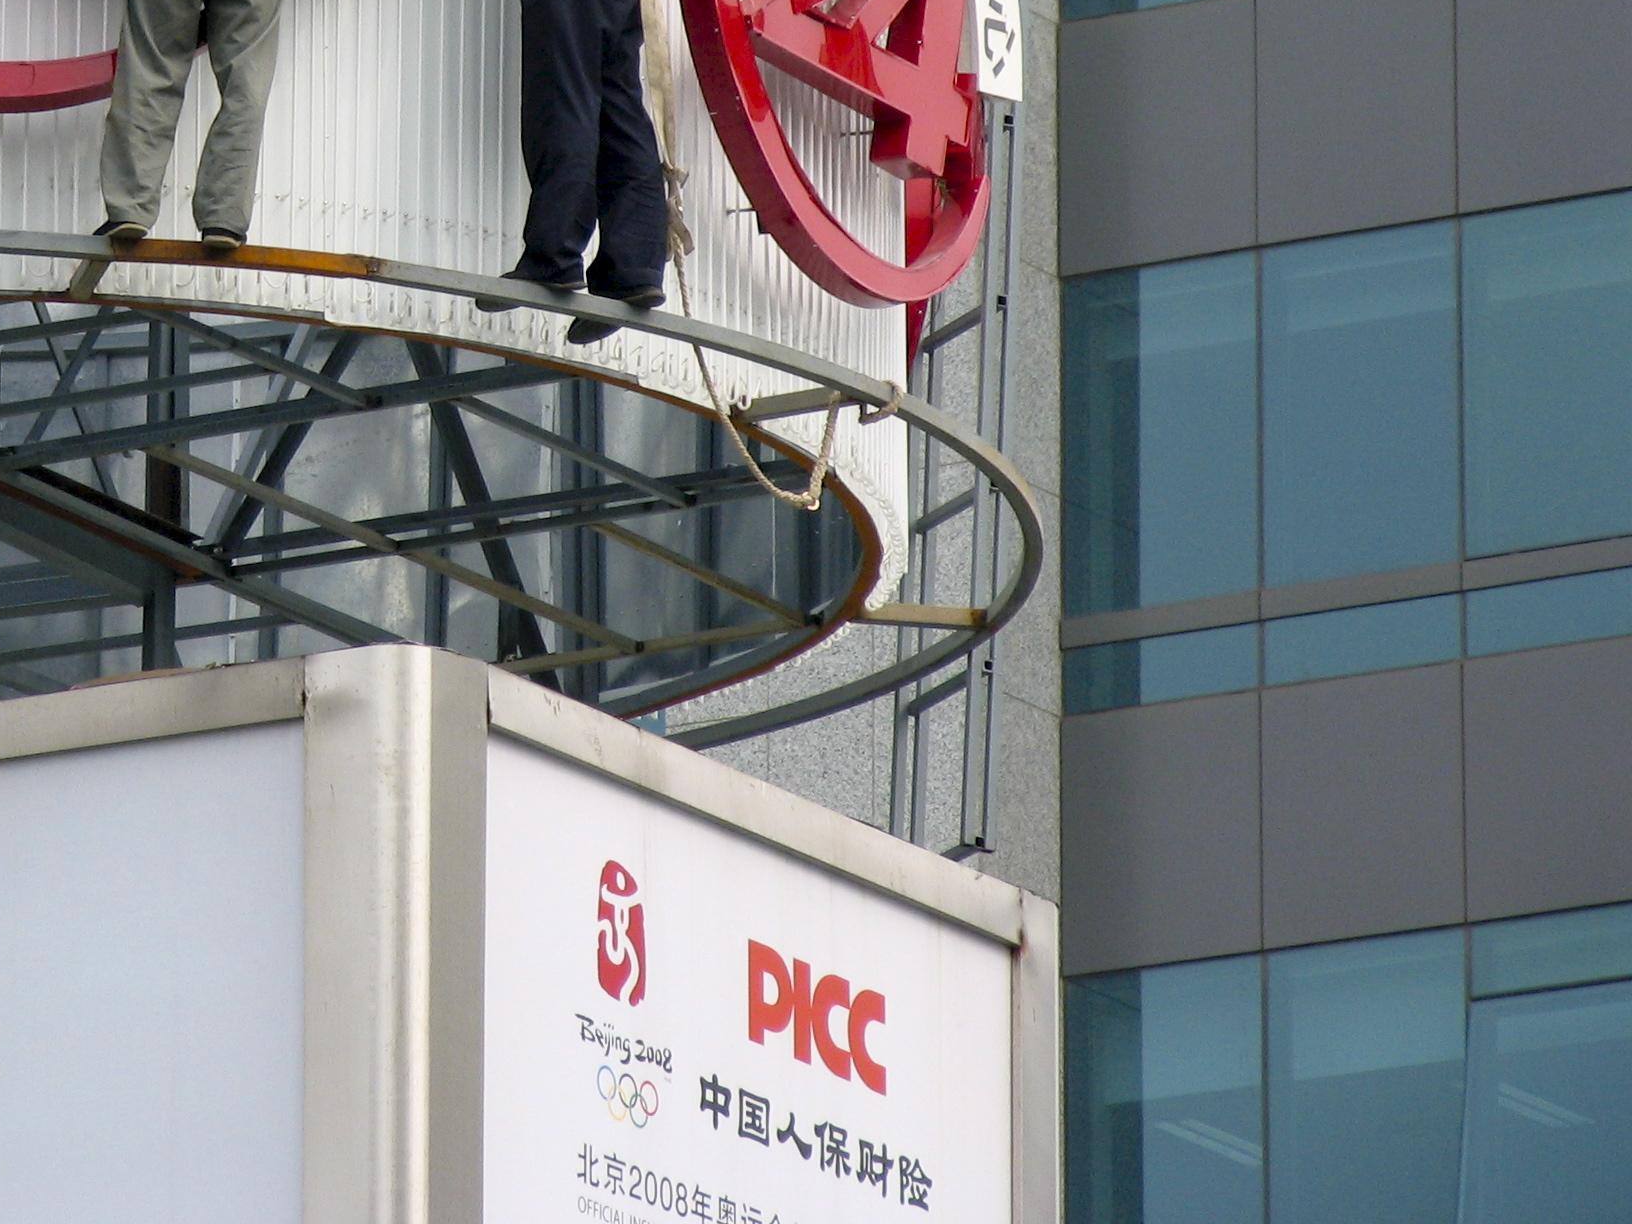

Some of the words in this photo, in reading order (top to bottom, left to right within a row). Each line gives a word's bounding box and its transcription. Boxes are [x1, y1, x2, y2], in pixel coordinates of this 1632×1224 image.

[575, 1013, 631, 1064] Beijing
[634, 1039, 672, 1073] 2008
[748, 939, 887, 1096] PICC
[699, 1073, 933, 1212] 中国人保财险
